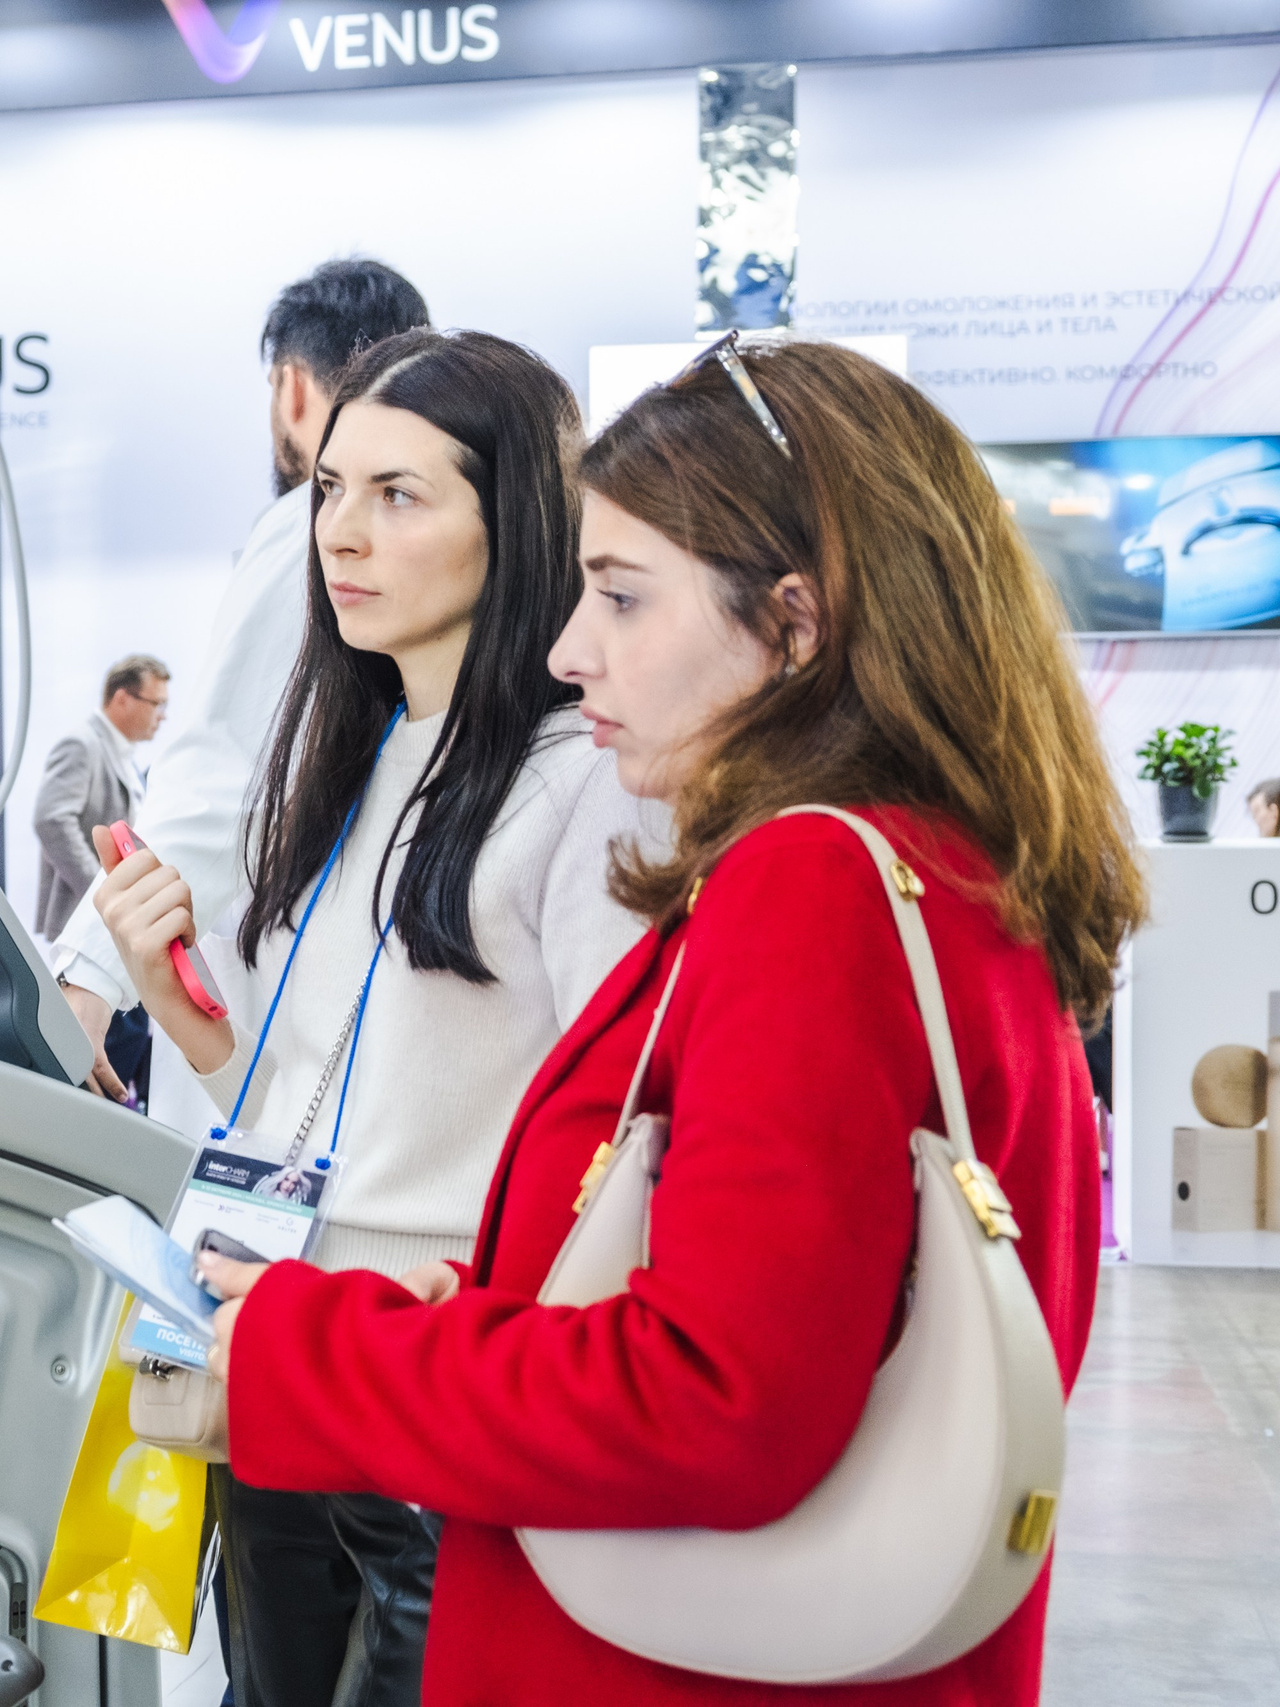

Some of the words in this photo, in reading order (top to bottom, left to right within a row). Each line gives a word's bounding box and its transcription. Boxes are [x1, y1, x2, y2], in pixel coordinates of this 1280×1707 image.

[289, 3, 499, 72] VENUS
[903, 291, 1076, 316] ОМОЛОЖЕНИЯ
[1081, 292, 1099, 310] И
[963, 317, 1030, 338] ЛИЦА
[1036, 318, 1054, 335] И
[1060, 316, 1117, 335] ТЕЛА
[1066, 361, 1218, 382] КОМФОРТНО
[0, 410, 49, 428] ENCE
[179, 1347, 206, 1361] VISITO
